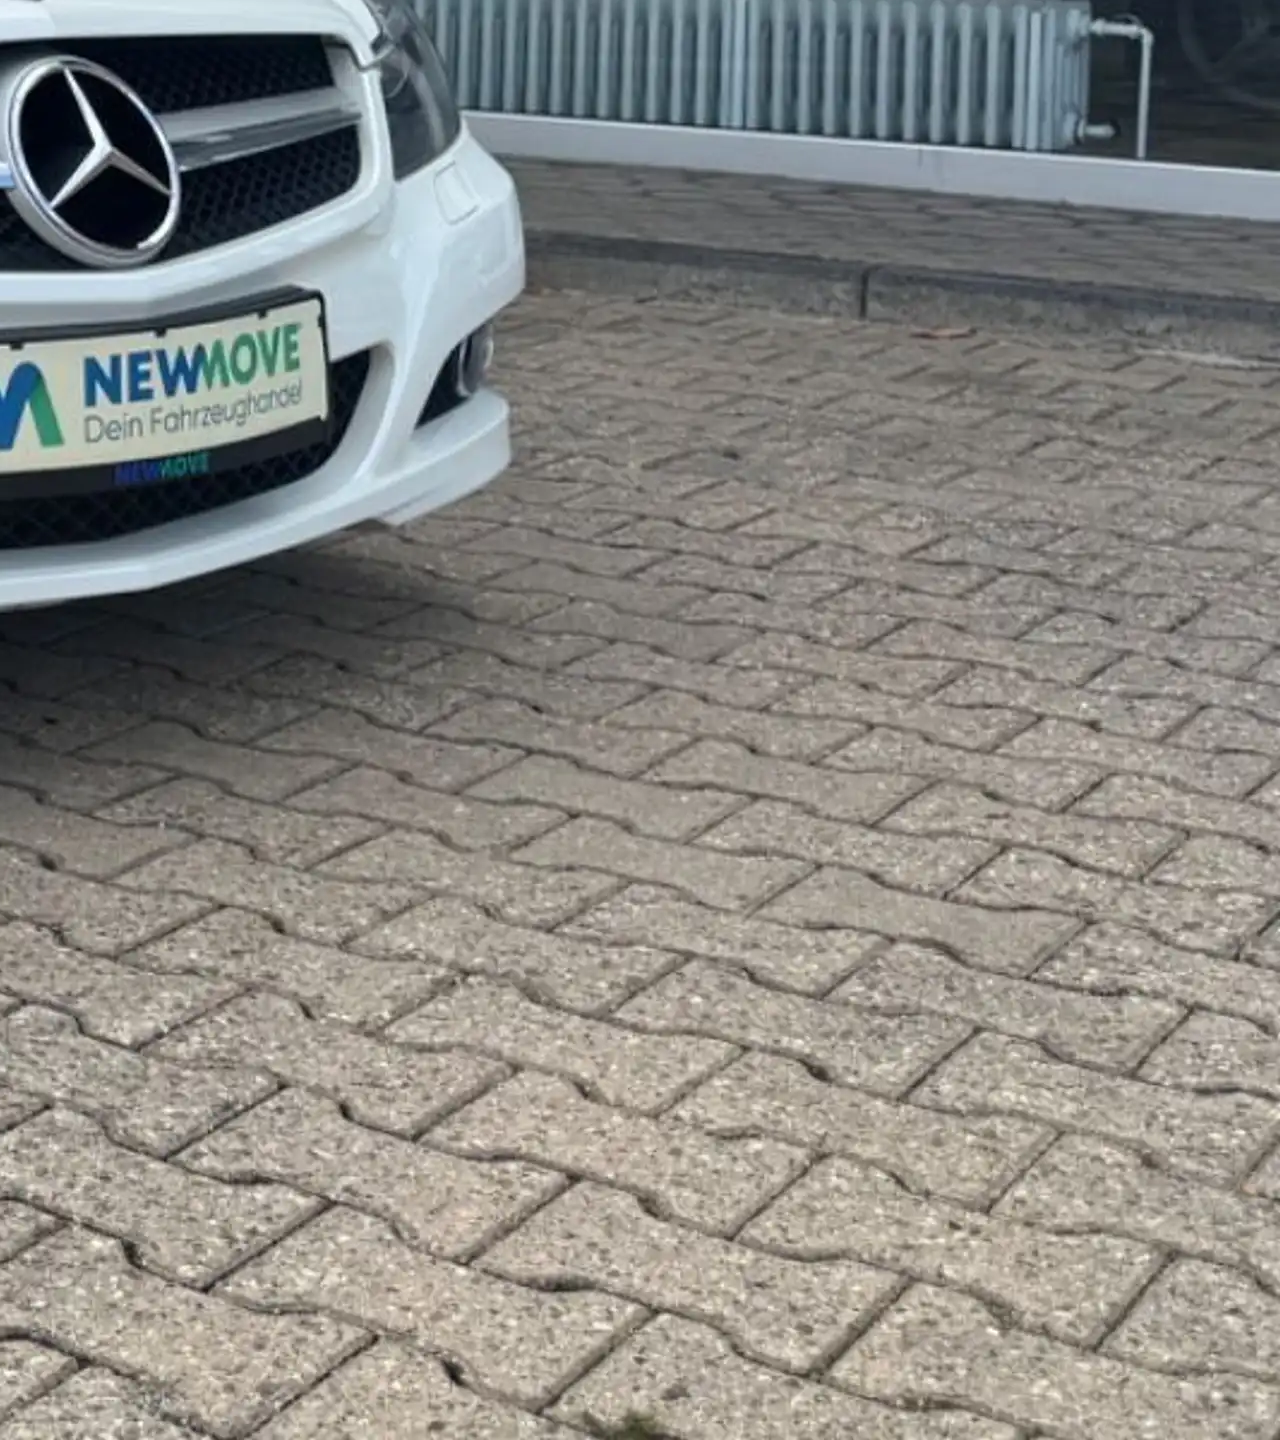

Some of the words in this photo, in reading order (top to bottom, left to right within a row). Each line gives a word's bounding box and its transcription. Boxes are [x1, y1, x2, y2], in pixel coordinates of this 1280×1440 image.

[83, 323, 302, 409] NEWMOVE
[84, 412, 144, 443] Dein
[150, 379, 302, 435] Fahrzeughandel
